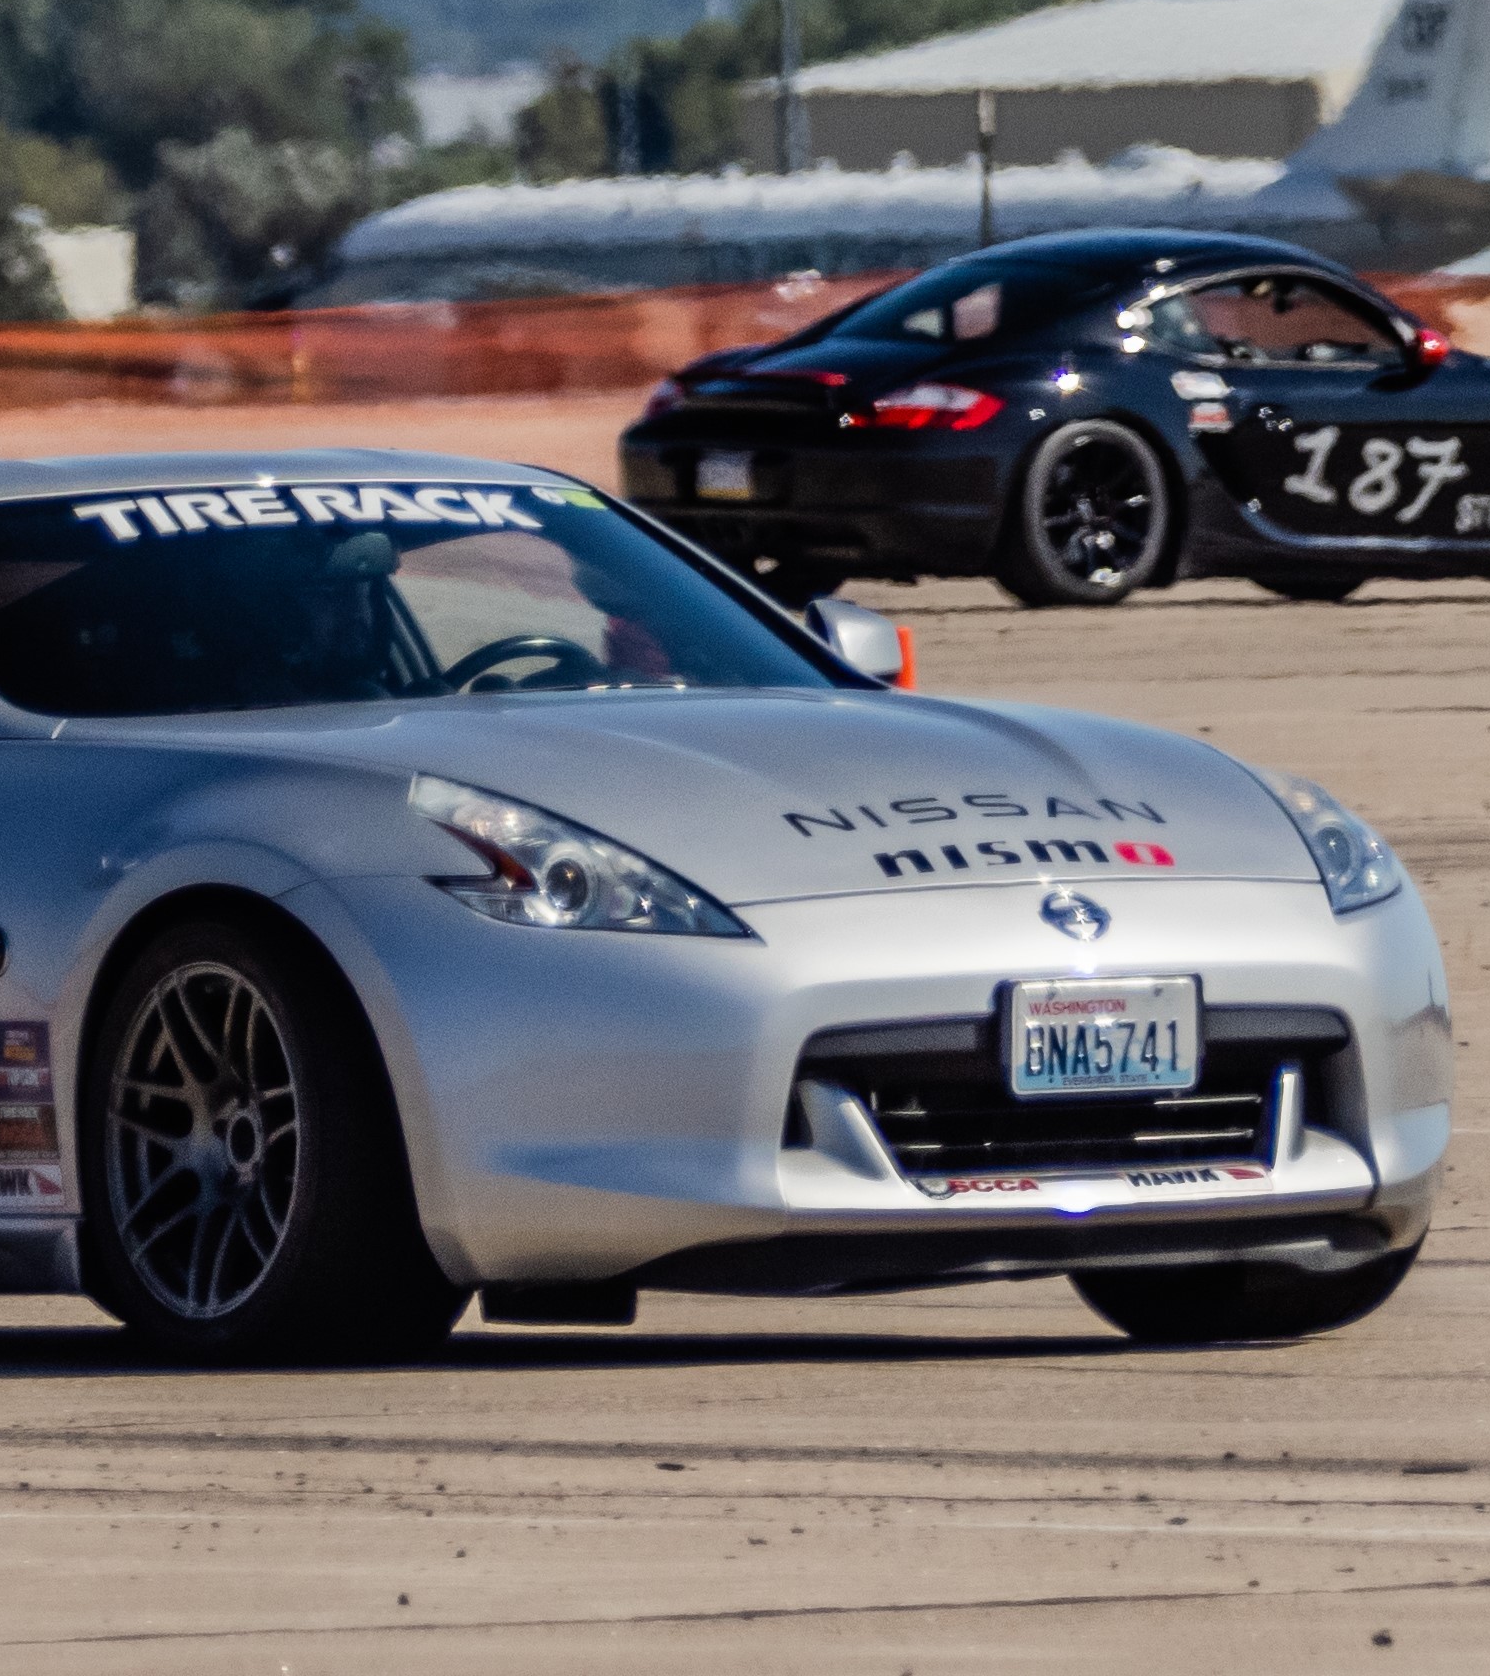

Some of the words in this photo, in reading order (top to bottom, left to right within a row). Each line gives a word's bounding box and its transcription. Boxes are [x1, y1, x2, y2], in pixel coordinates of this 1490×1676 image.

[1282, 424, 1469, 525] 187
[73, 487, 299, 542] TIRE
[291, 486, 544, 529] RACK
[782, 794, 1167, 838] NISSAN
[873, 839, 1175, 878] nismo
[1028, 998, 1127, 1016] WASHINGTON
[1125, 1168, 1221, 1187] HAWK
